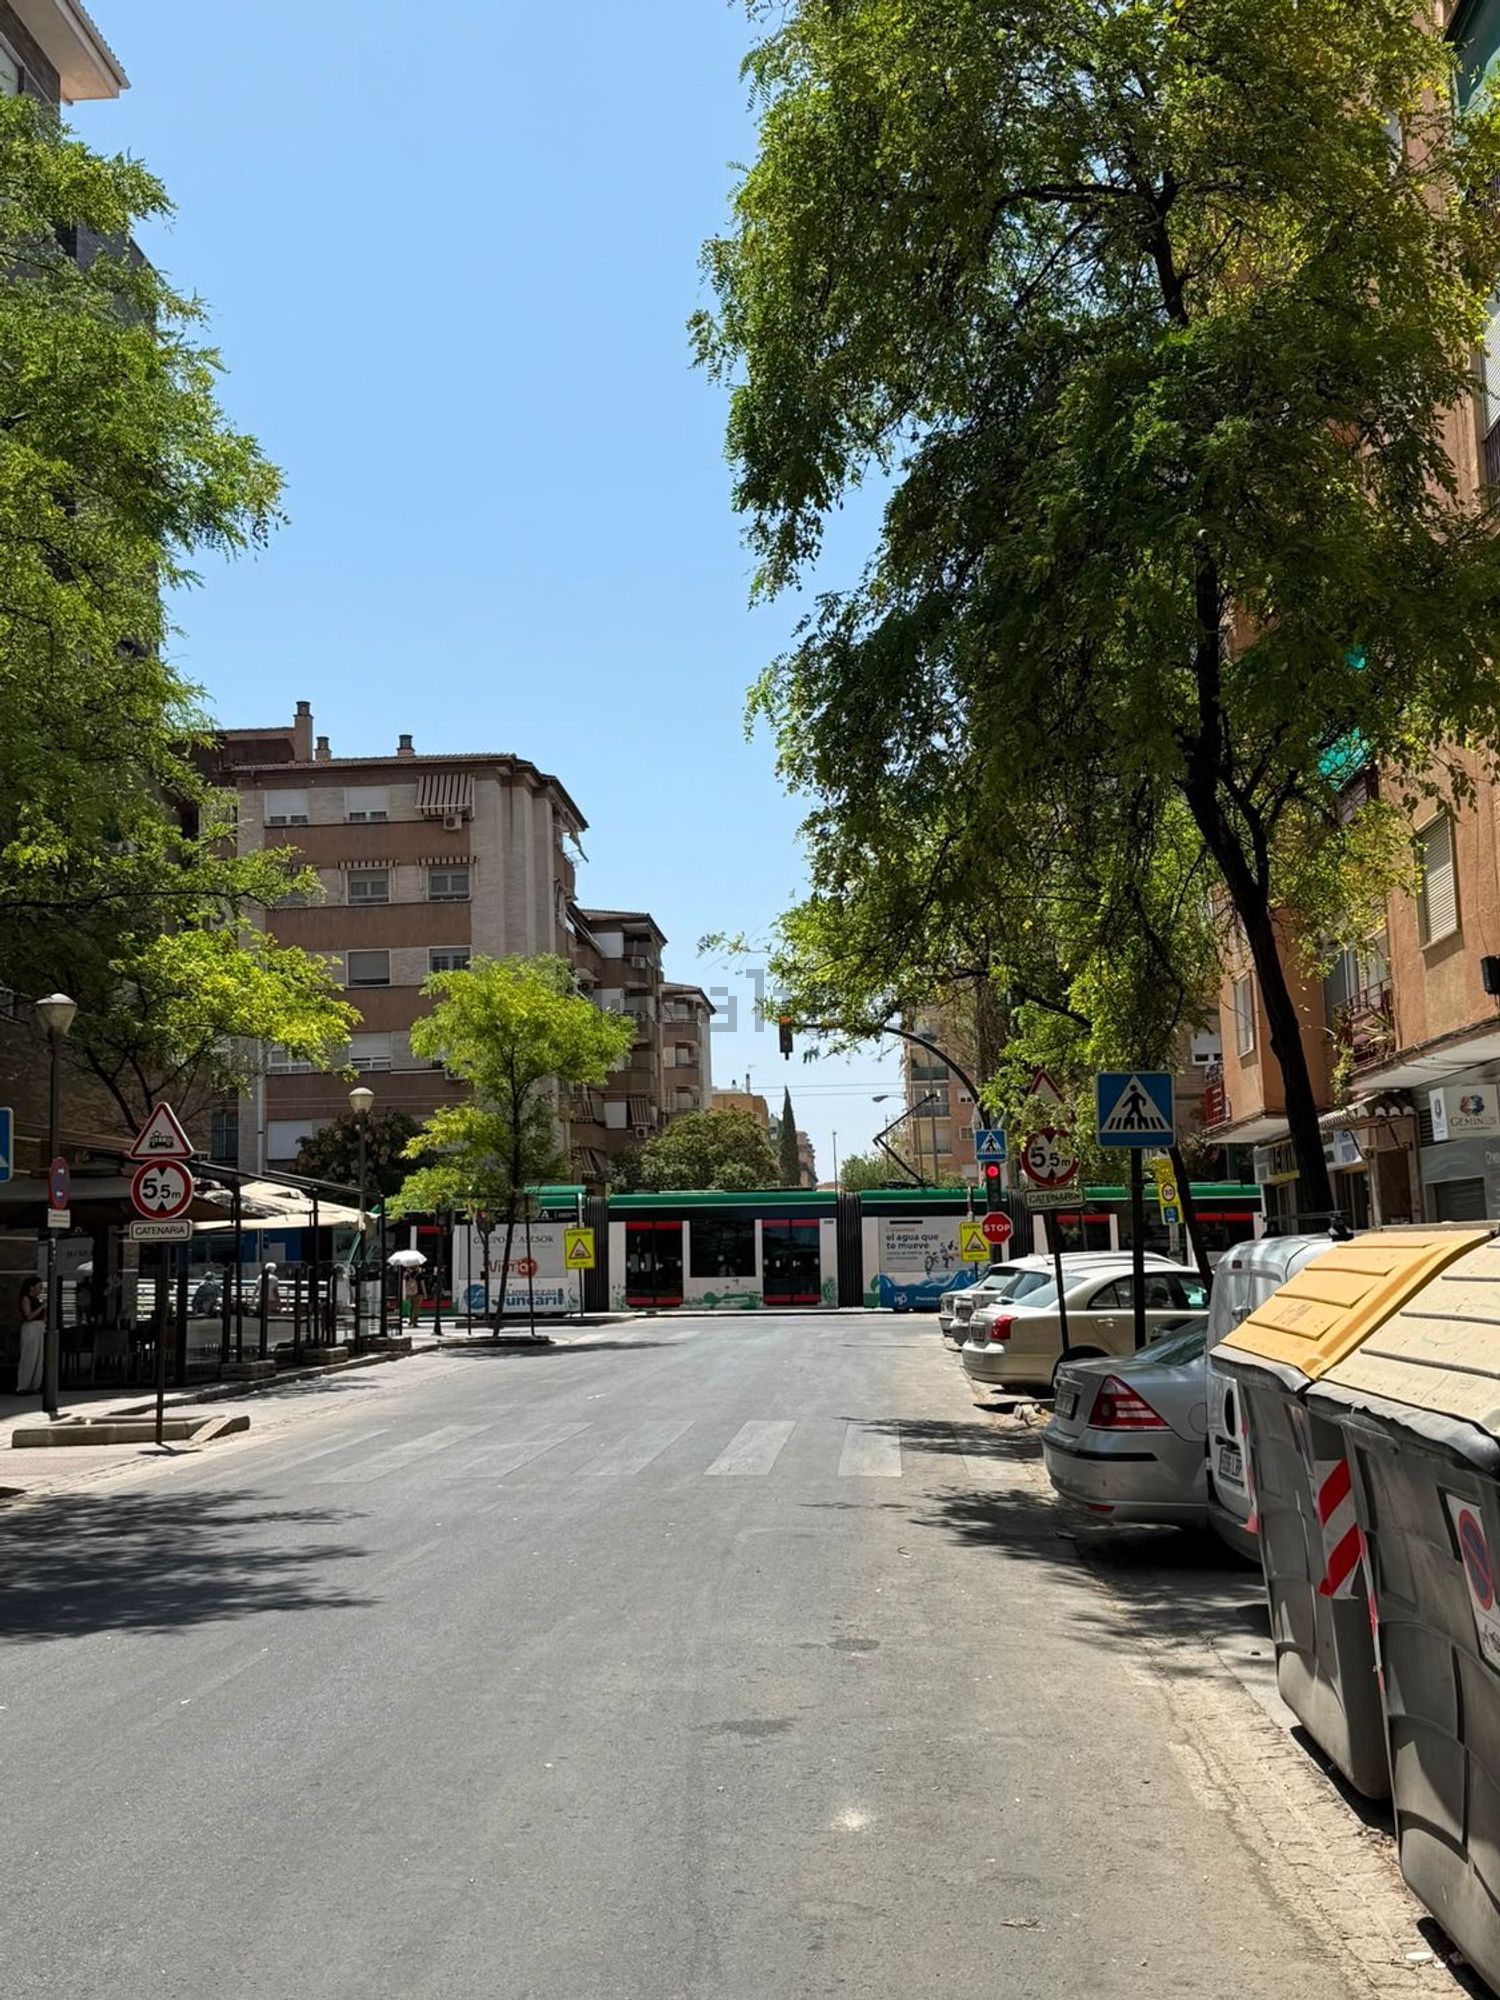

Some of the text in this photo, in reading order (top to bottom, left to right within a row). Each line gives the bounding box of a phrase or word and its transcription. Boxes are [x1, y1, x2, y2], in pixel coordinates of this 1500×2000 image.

[135, 1227, 185, 1235] CATENARIA
[983, 1223, 1011, 1232] STOP
[518, 1235, 554, 1243] AESOR
[896, 1234, 919, 1243] agua
[921, 1234, 939, 1242] que
[506, 1288, 556, 1297] Limpezas
